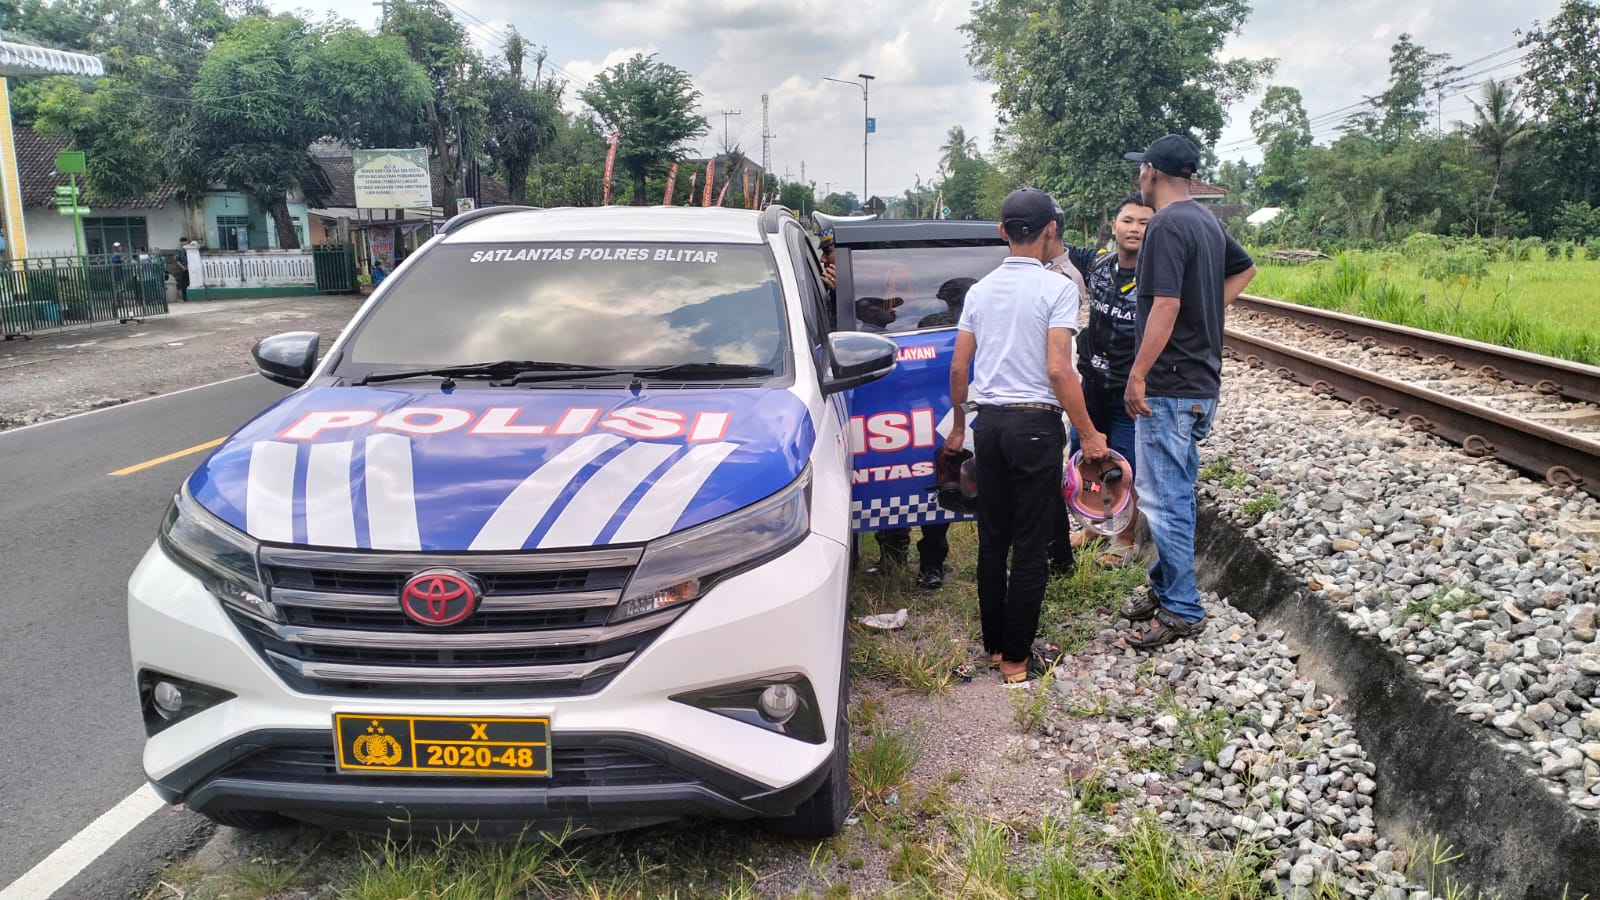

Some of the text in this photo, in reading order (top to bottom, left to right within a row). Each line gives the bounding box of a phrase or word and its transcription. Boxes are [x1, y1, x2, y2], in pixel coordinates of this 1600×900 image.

[470, 248, 718, 263] SATLANTAS POLRES BLITAR
[278, 406, 731, 442] POLISI
[470, 723, 488, 740] X
[427, 746, 534, 767] 2020-48
